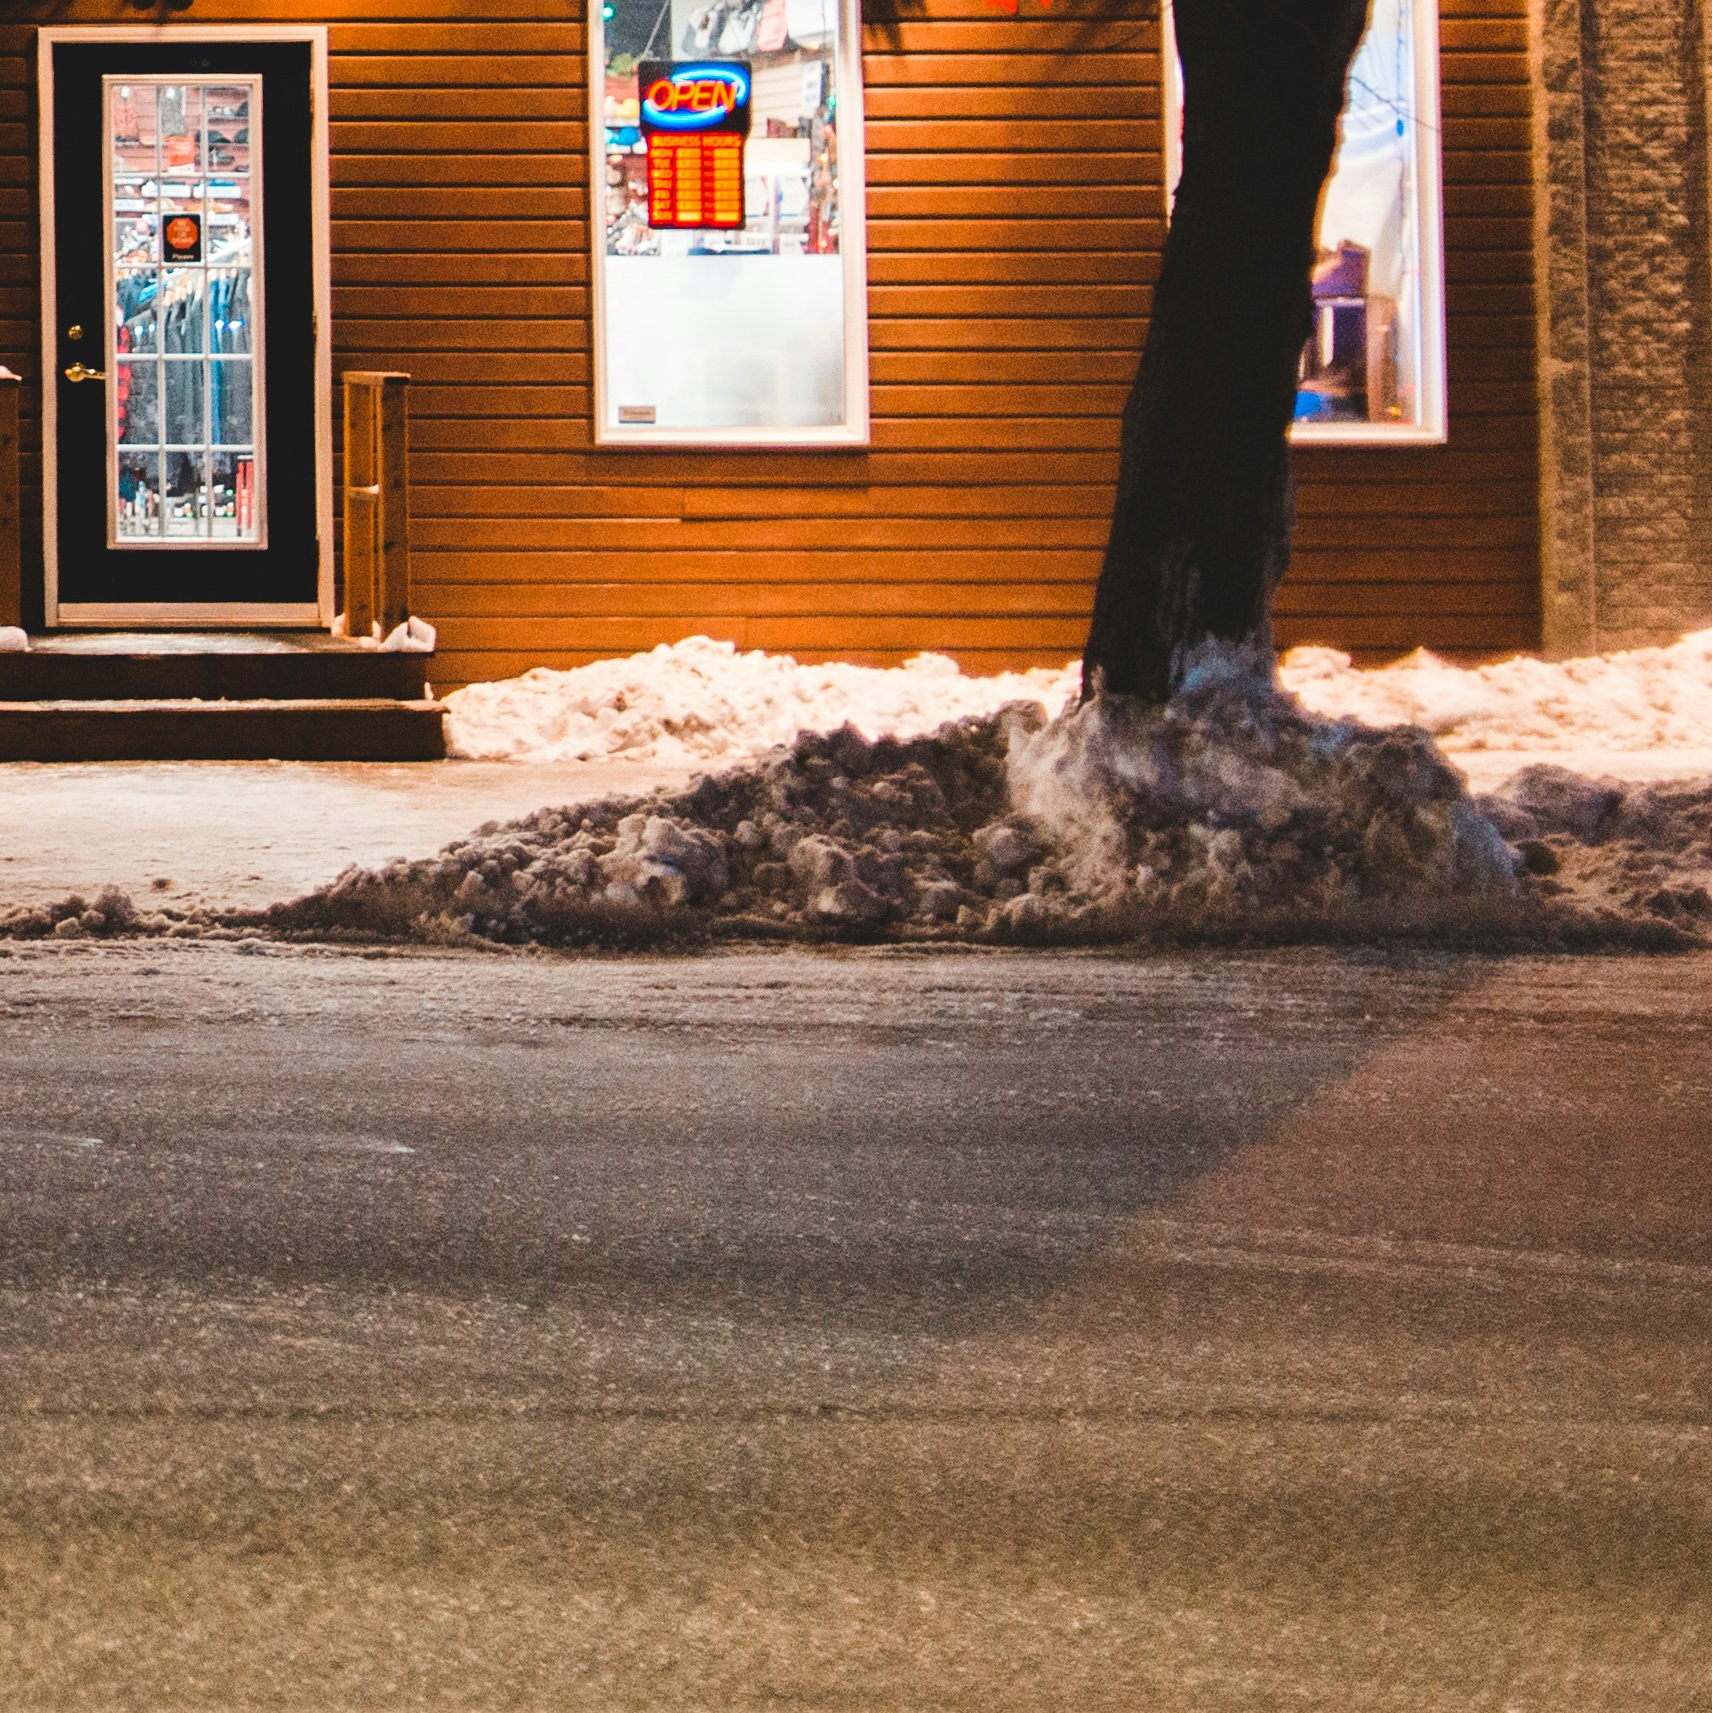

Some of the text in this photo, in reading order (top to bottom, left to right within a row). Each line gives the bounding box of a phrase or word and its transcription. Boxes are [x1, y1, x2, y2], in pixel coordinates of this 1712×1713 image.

[647, 79, 738, 114] OPEN
[652, 135, 741, 147] BUSINESS HOURS
